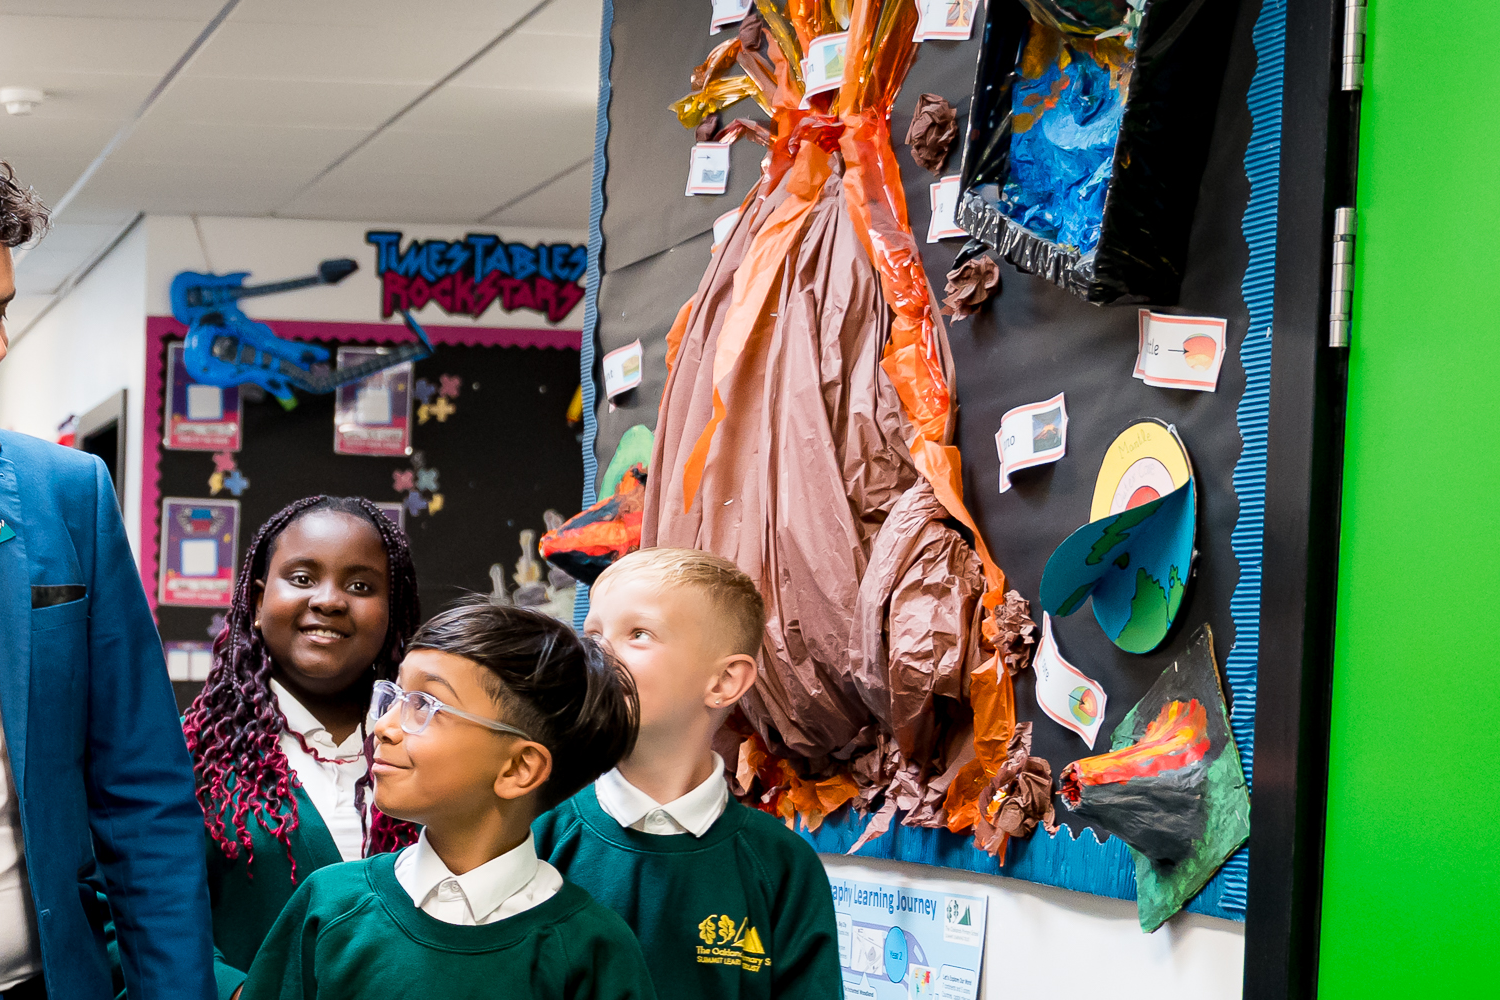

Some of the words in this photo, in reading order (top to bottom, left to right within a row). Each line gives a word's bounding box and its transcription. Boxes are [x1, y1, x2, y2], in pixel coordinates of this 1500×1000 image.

[854, 884, 895, 915] Learning
[896, 890, 937, 921] Journey
[696, 945, 711, 955] The
[697, 955, 723, 964] SUMMIT
